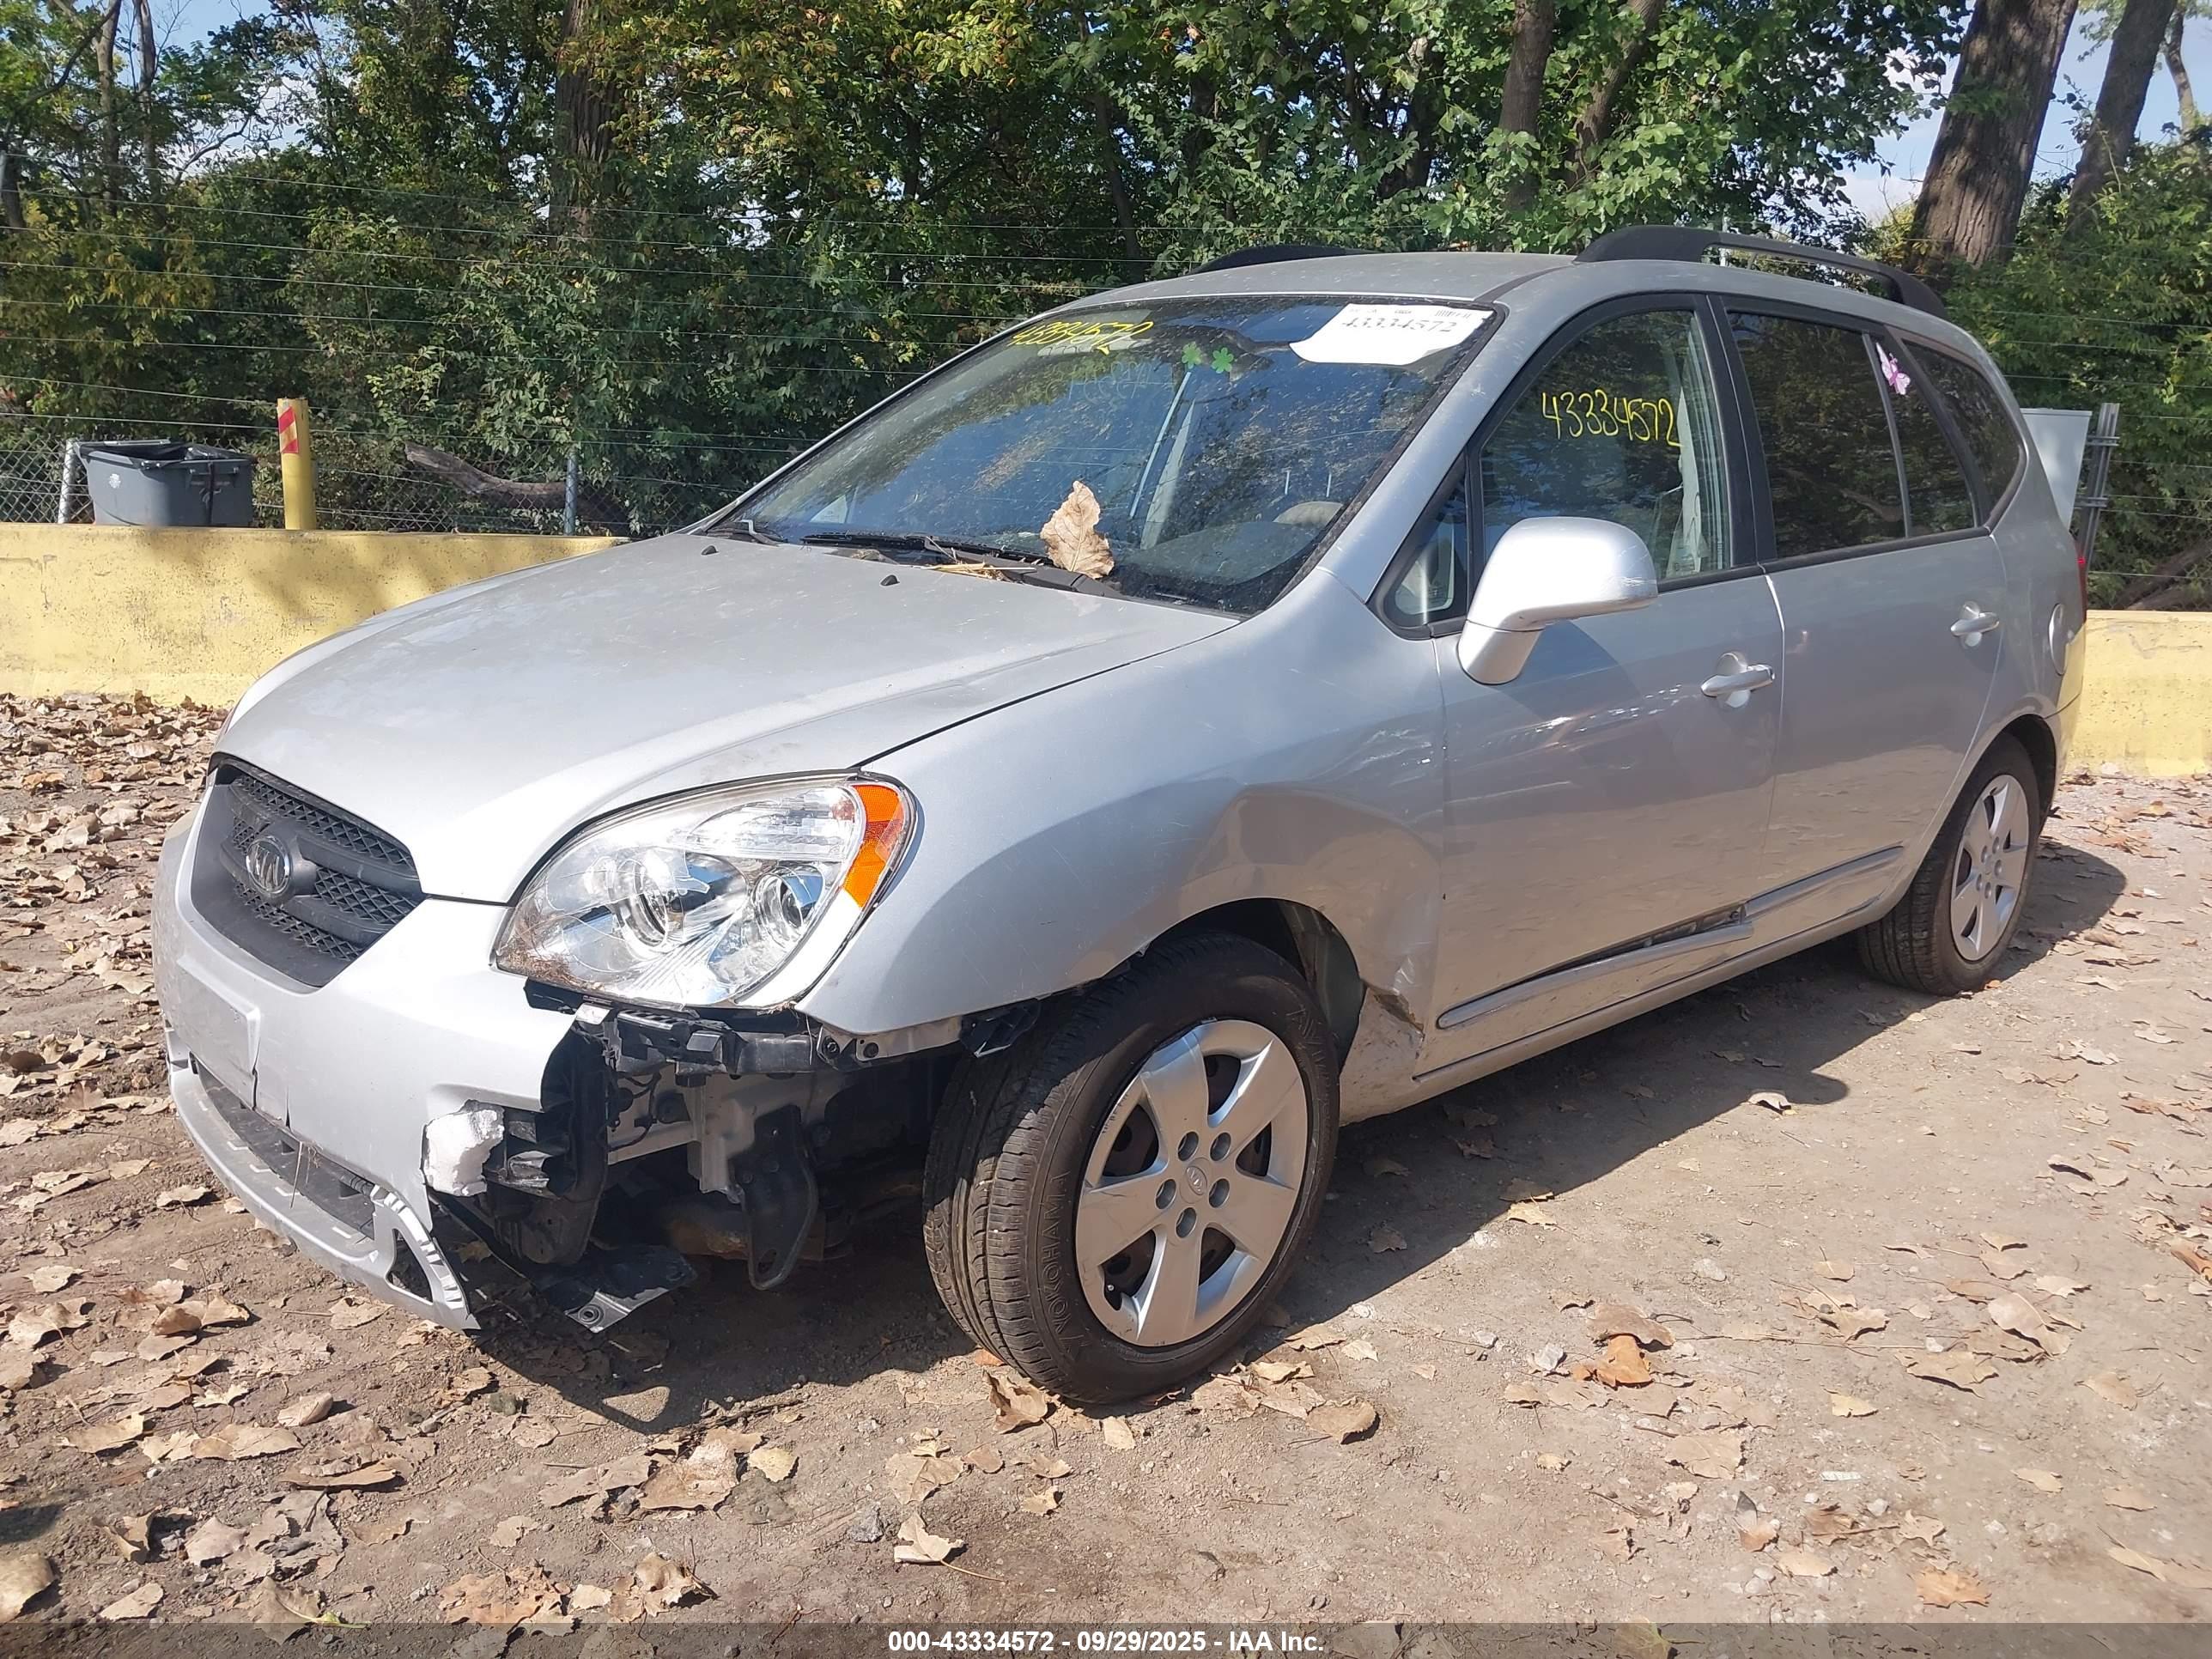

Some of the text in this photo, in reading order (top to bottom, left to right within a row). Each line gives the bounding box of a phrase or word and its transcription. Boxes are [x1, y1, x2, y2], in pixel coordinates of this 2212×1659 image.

[1342, 316, 1457, 332] 43334572
[1542, 389, 1684, 447] 43334572
[1042, 1170, 1072, 1334] YOKOHAMA
